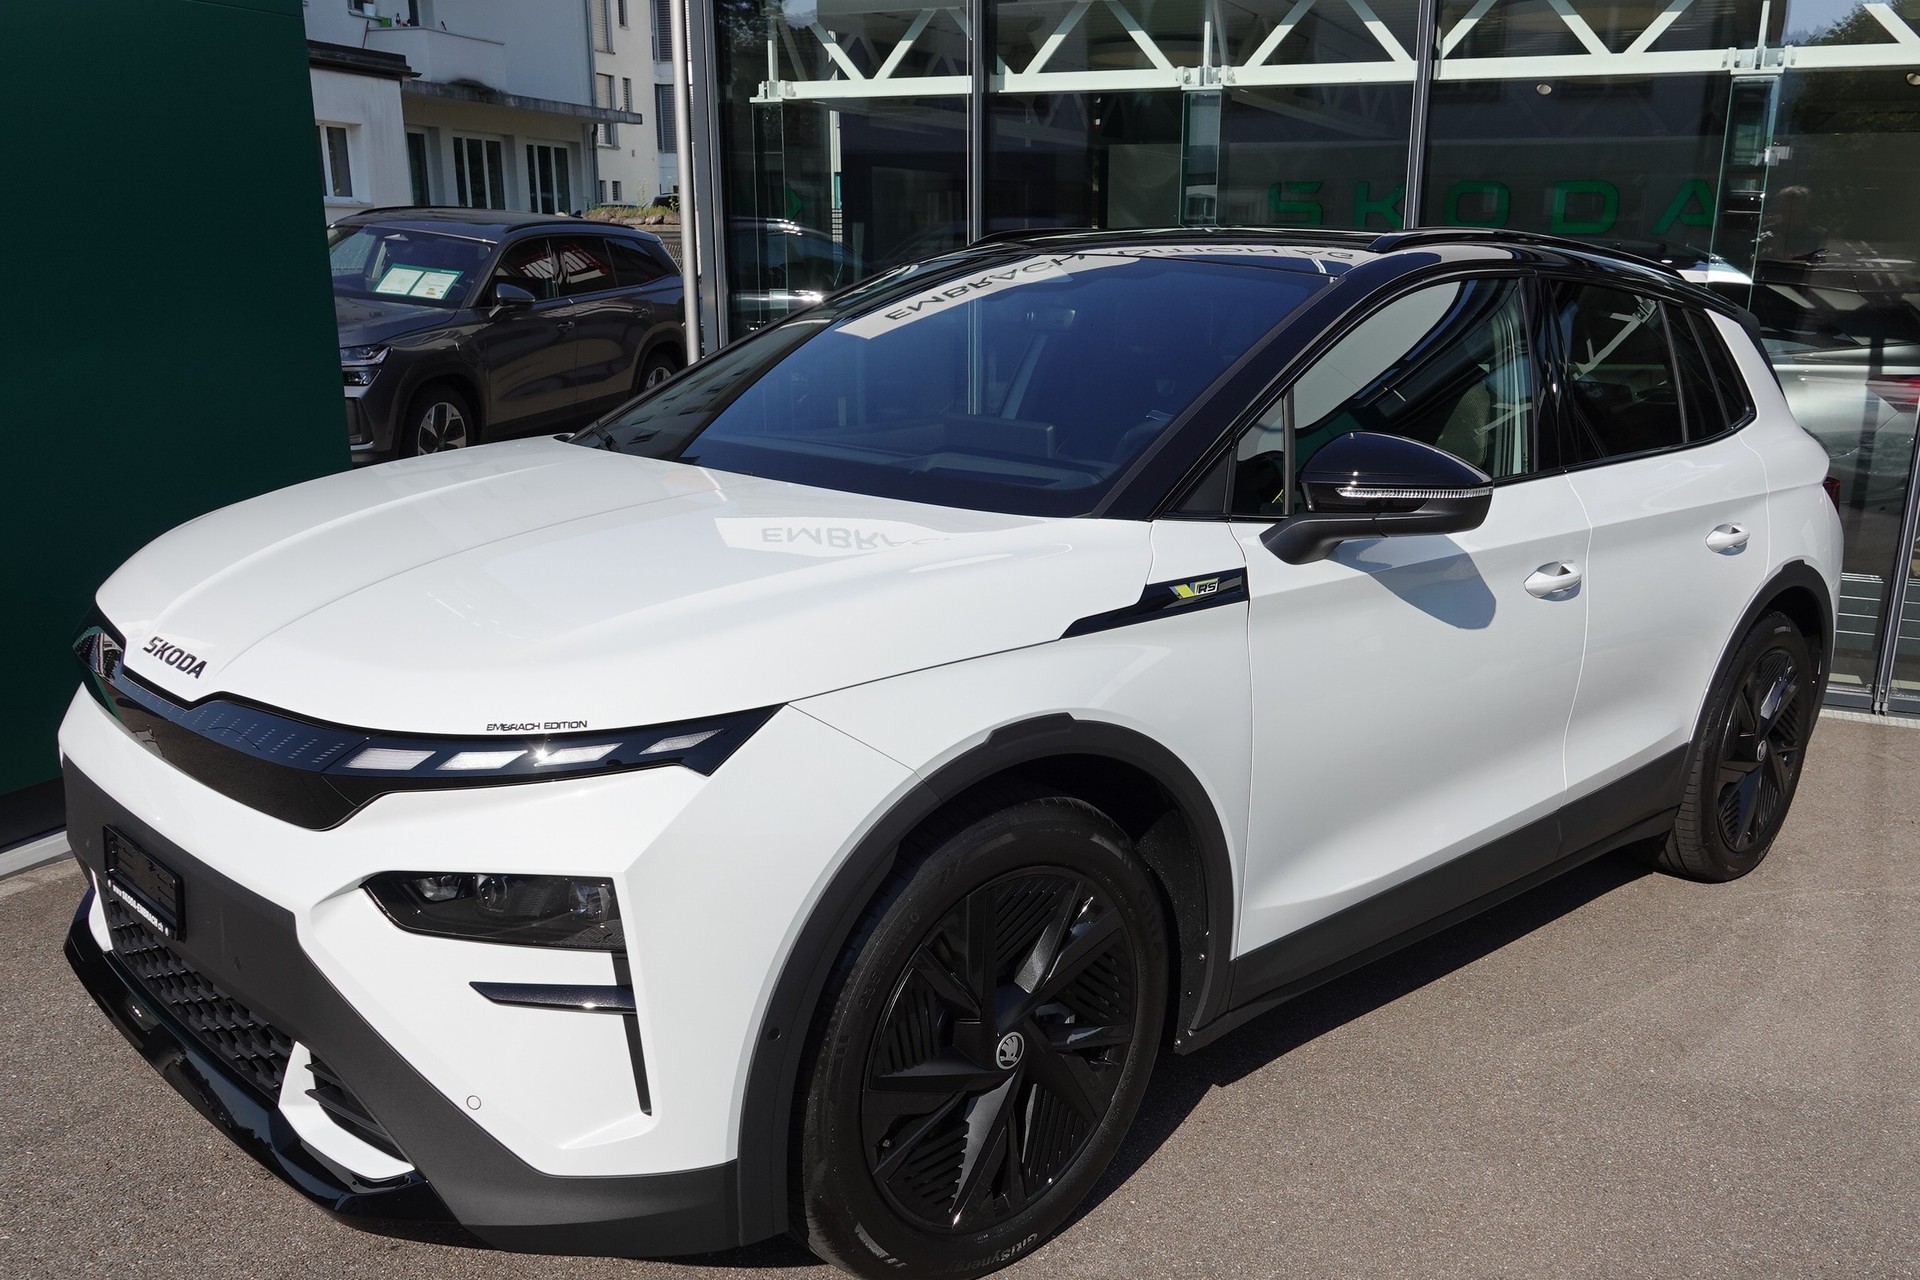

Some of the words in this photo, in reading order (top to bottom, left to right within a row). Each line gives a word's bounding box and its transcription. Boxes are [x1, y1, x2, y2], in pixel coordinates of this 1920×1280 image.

[1268, 179, 1715, 236] SKODA
[142, 635, 208, 680] SKODA
[486, 722, 540, 732] EMBRACH
[543, 720, 588, 730] EDITION
